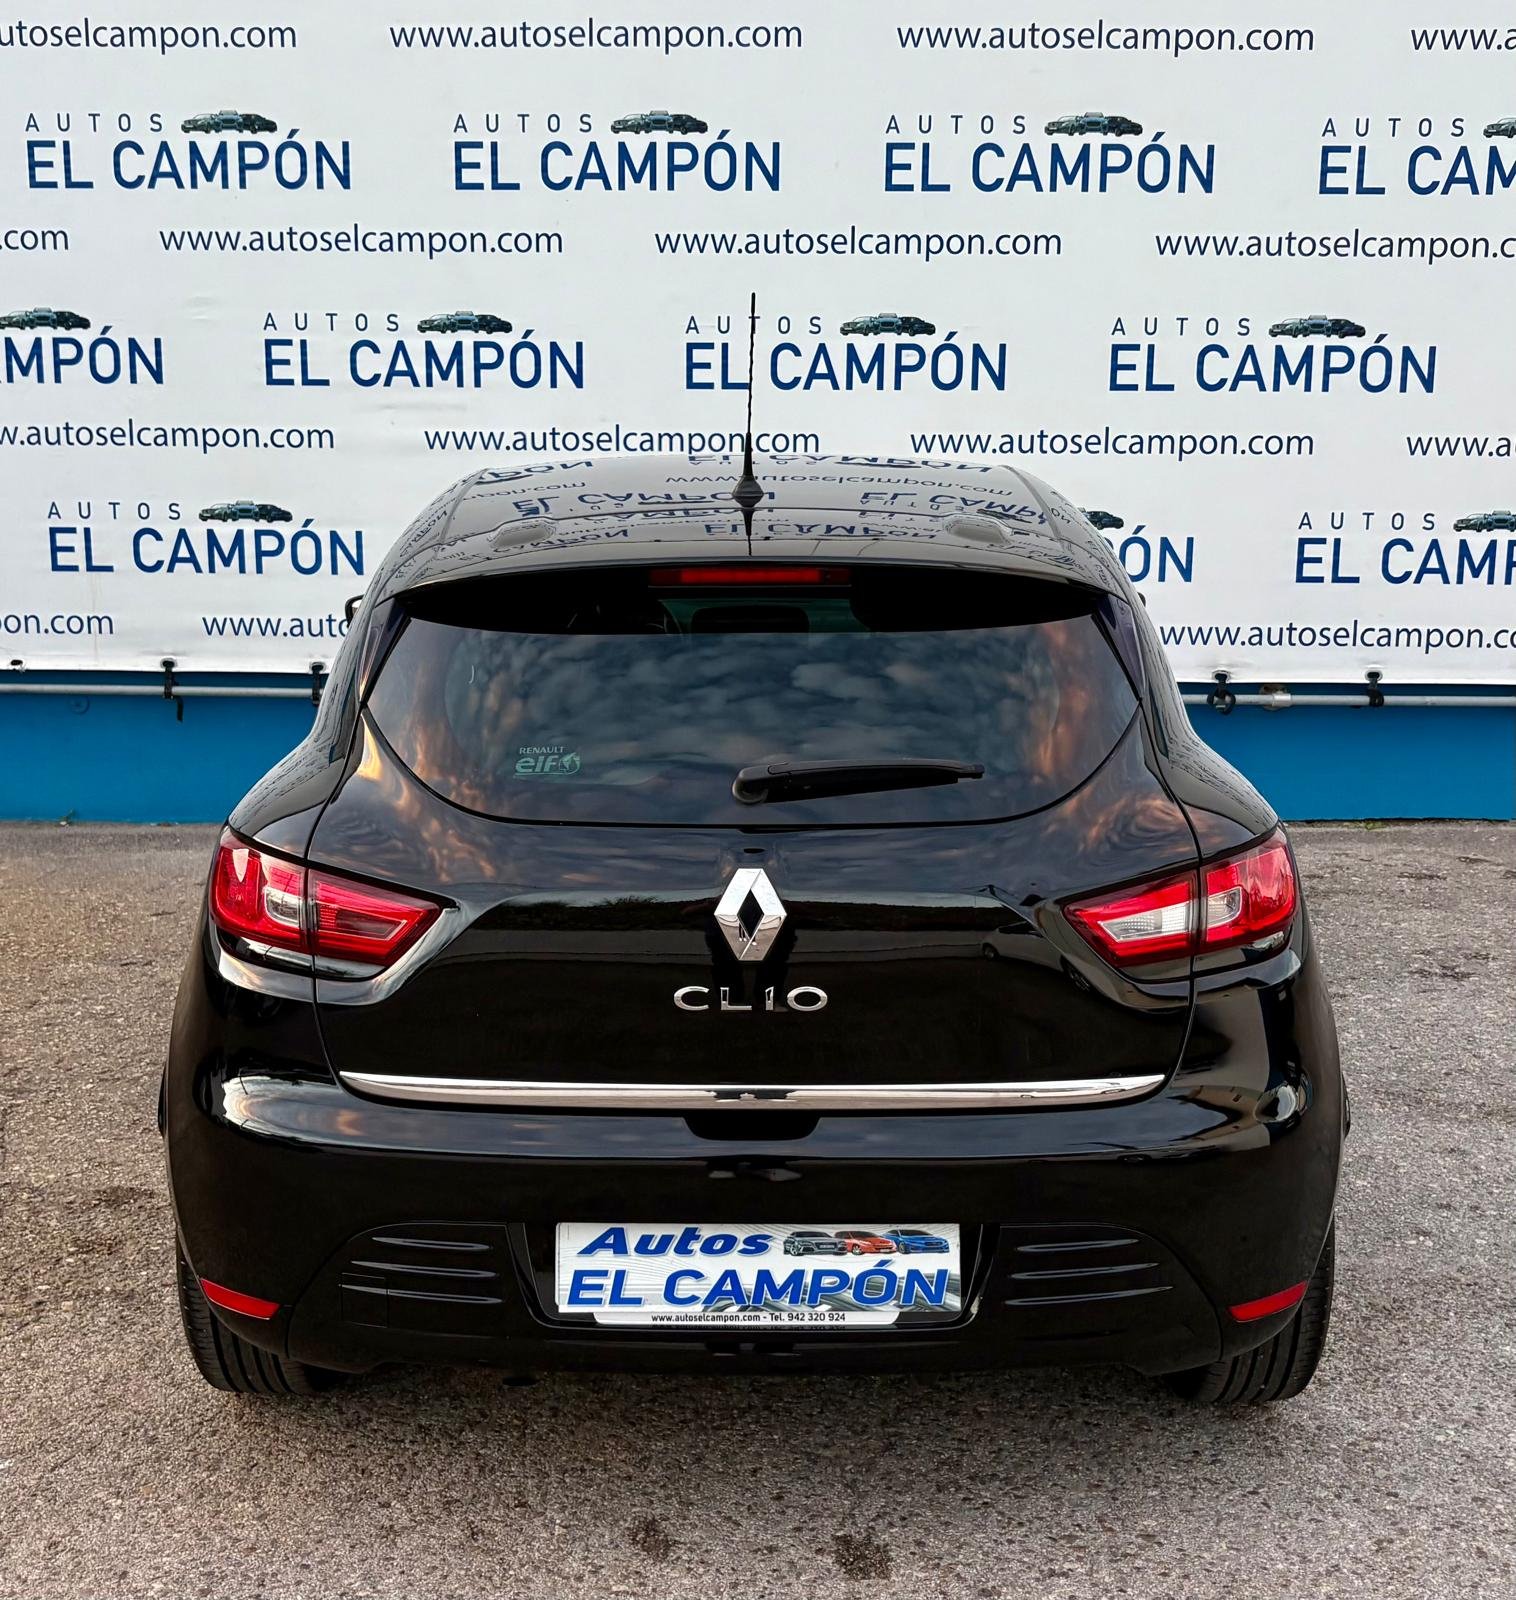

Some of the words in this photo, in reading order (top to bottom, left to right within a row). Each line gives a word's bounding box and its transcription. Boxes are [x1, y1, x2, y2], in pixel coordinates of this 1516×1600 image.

[389, 17, 802, 56] www.autoselcampon.com
[896, 18, 1314, 58] www.autoselcampon.com
[25, 112, 163, 133] AUTOS
[453, 113, 592, 134] AUTOS
[885, 114, 1026, 135] AUTOS
[1321, 117, 1465, 138] AUTOS
[26, 140, 95, 190] EL
[112, 128, 352, 191] CAMPÓN
[454, 140, 521, 191] EL
[540, 129, 781, 192] CAMPÓN
[884, 142, 951, 193] EL
[971, 132, 1216, 194] CAMPÓN
[1318, 145, 1386, 196] EL
[159, 223, 563, 261] www.autoselcampon.com
[654, 224, 1062, 263] www.autoselcampon.com
[1155, 227, 1516, 266] www.autoselcampon.c
[263, 312, 399, 333] AUTOS
[685, 315, 822, 335] AUTOS
[1110, 316, 1251, 337] AUTOS
[0, 325, 164, 385] MPÓN
[264, 338, 331, 387] EL
[349, 328, 584, 390] CAMPÓN
[685, 342, 750, 390] EL
[769, 331, 1007, 392] CAMPÓN
[1108, 343, 1176, 392] EL
[1195, 334, 1437, 394] CAMPÓN
[423, 422, 820, 455] www.autoselcamponcom
[910, 426, 1314, 462] www.autoselcampon.com
[48, 502, 181, 521] AUTOS
[1297, 511, 1436, 531] AUTOS
[48, 526, 115, 573] EL
[132, 518, 365, 576] CAMPÓN
[1295, 537, 1361, 584] EL
[519, 746, 565, 755] RENAULT
[673, 985, 828, 1011] CLIO
[577, 1226, 774, 1256] Autos
[566, 1269, 644, 1306] EL
[662, 1259, 949, 1306] CAMPÓN
[651, 1313, 761, 1323] www.autoselcampon.com
[769, 1312, 785, 1322] Tel.
[787, 1312, 806, 1322] 942
[807, 1312, 826, 1322] 320
[828, 1312, 846, 1322] 924
